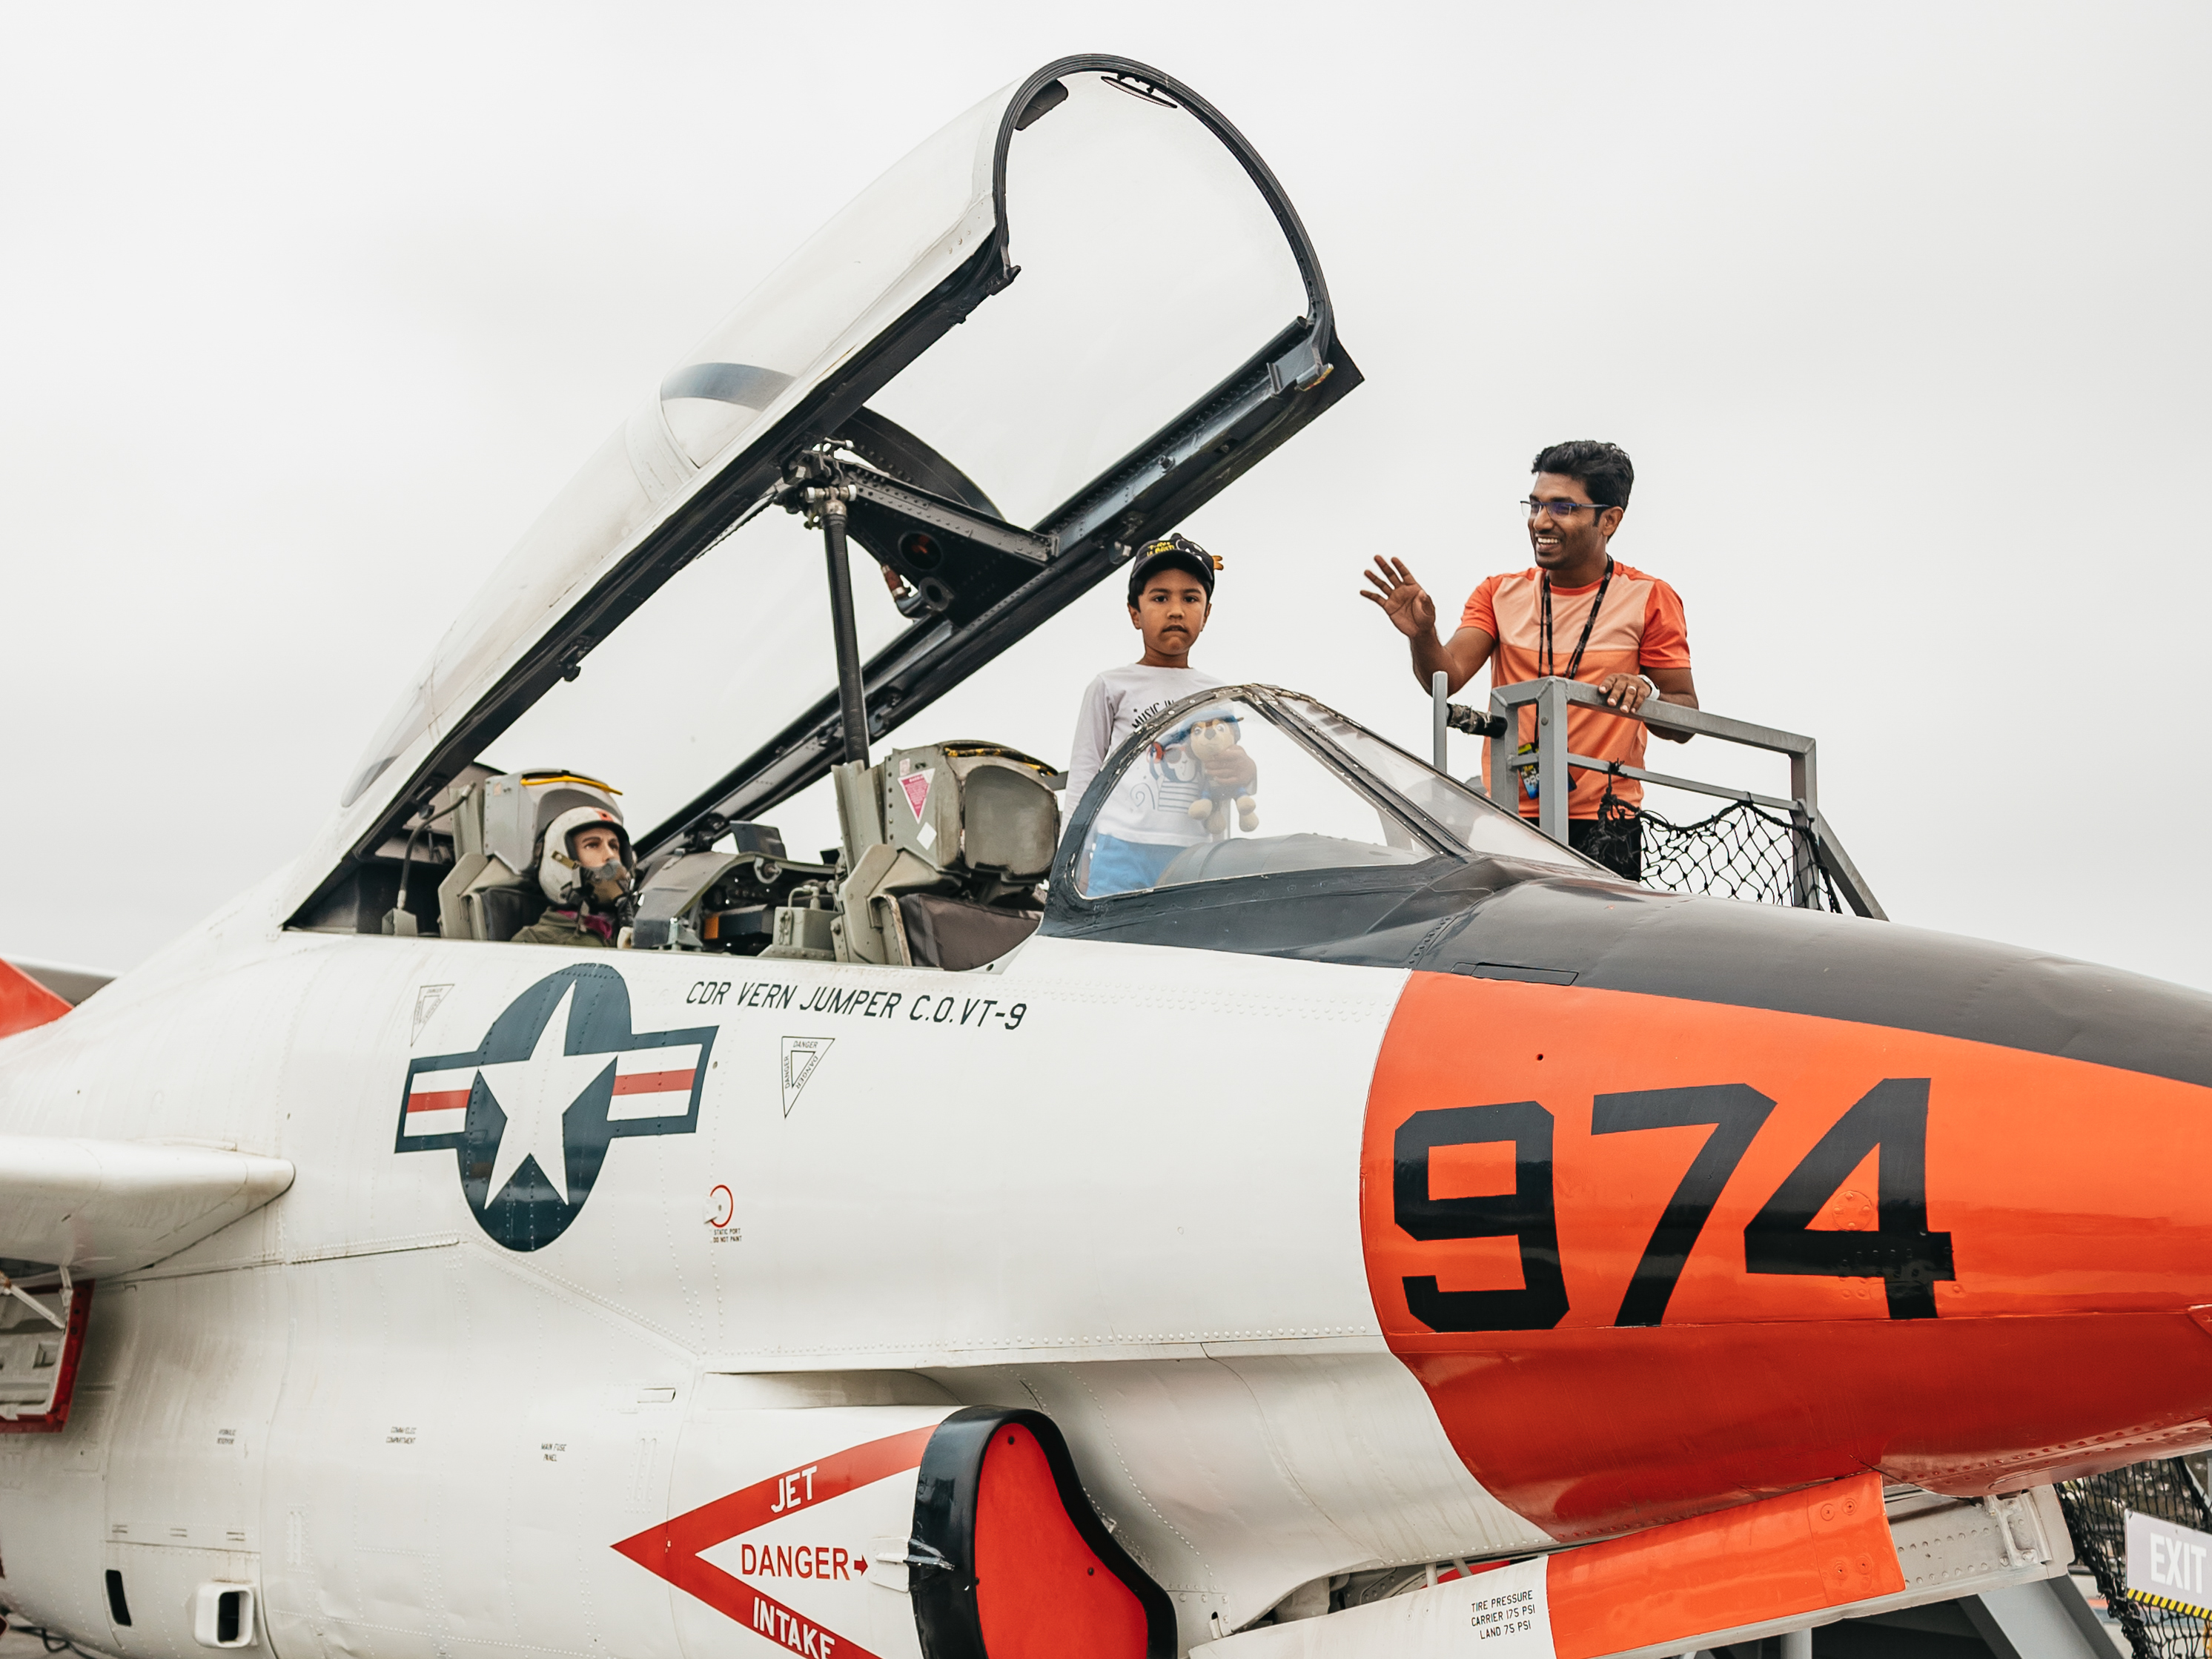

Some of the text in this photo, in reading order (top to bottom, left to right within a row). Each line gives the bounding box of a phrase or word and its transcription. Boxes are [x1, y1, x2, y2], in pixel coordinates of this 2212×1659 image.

[686, 981, 732, 1005] CDR
[737, 982, 798, 1010] VERN
[799, 987, 901, 1019] JUMPER
[795, 1056, 818, 1089] DANGER
[1394, 1078, 1956, 1332] 974
[554, 1443, 567, 1451] FUSE
[771, 1466, 817, 1513] JET
[741, 1543, 850, 1580] DANGER
[2150, 1532, 2207, 1594] EXIT
[1471, 1590, 1533, 1612] TIRE PRESSURE
[1471, 1604, 1535, 1626] CARRIER 175 PSI
[753, 1596, 835, 1659] INTAKE
[1480, 1620, 1531, 1640] LAND 75 PSI
